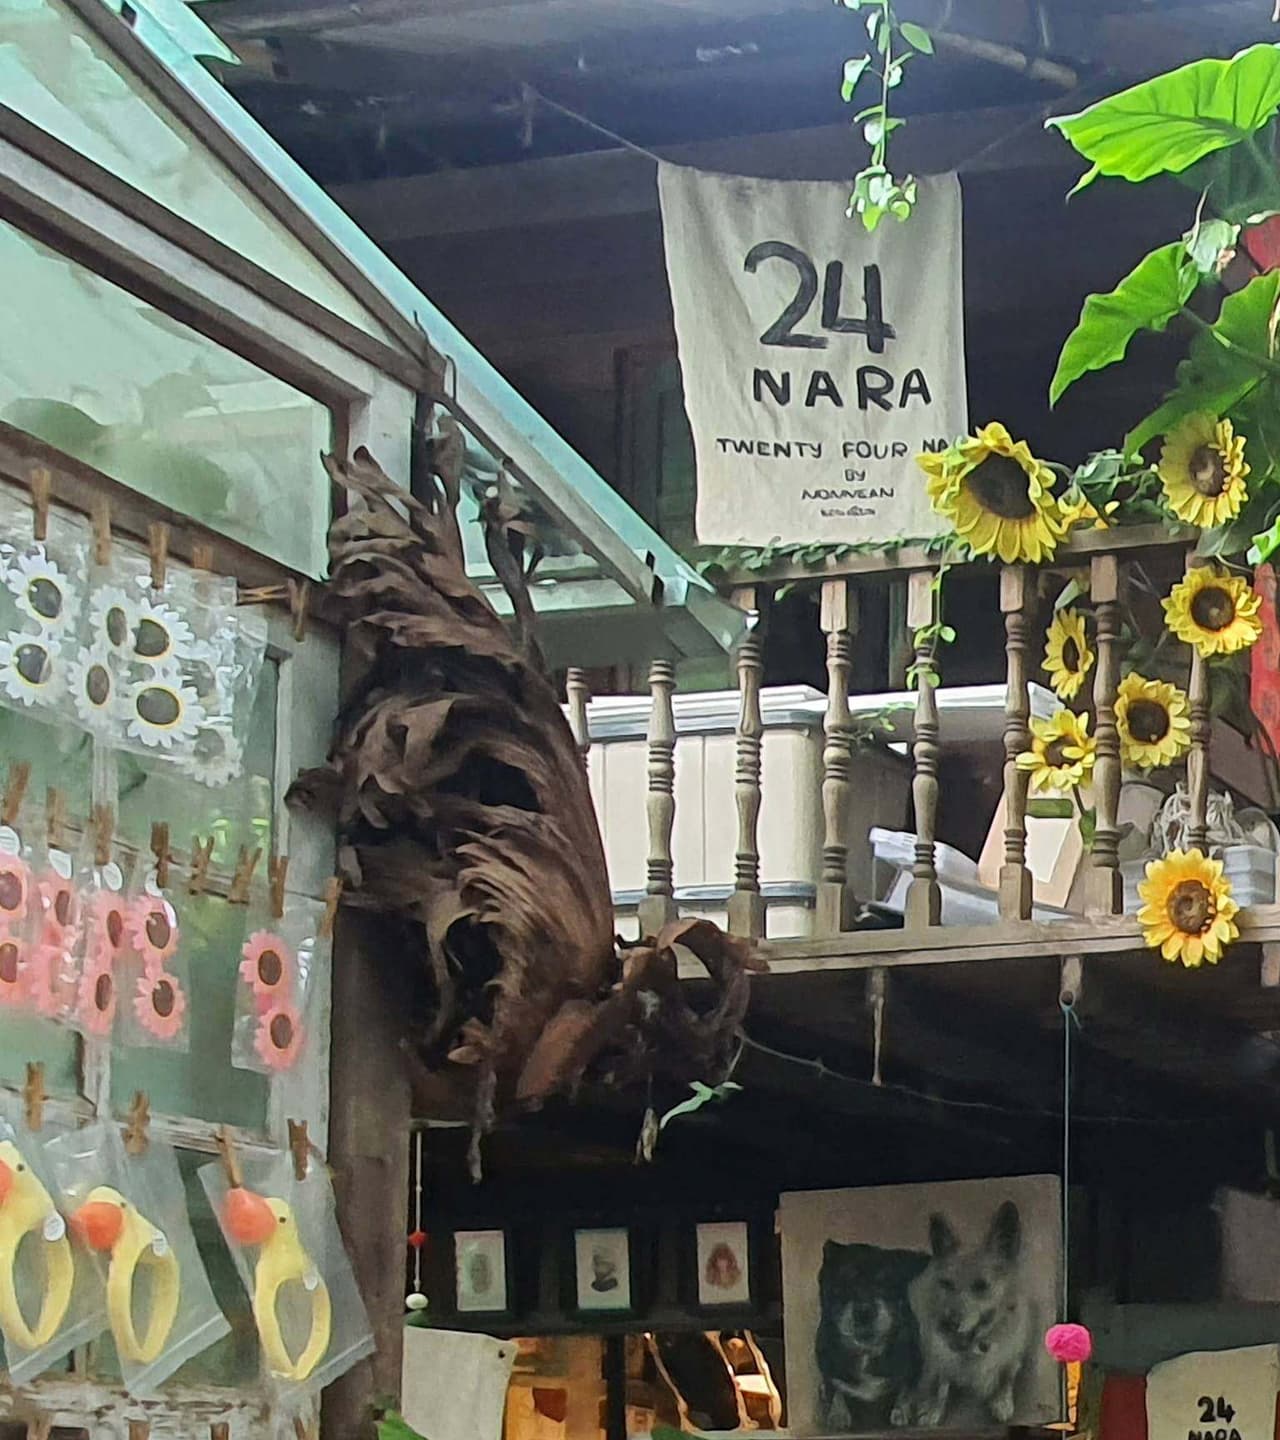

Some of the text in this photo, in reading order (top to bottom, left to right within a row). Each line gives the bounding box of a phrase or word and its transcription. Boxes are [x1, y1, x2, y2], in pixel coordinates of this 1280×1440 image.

[743, 240, 897, 354] 24
[752, 365, 933, 411] NARA
[716, 437, 822, 459] TWENTY
[842, 440, 908, 460] FOUR
[844, 468, 867, 482] BY
[1197, 1395, 1236, 1424] 24
